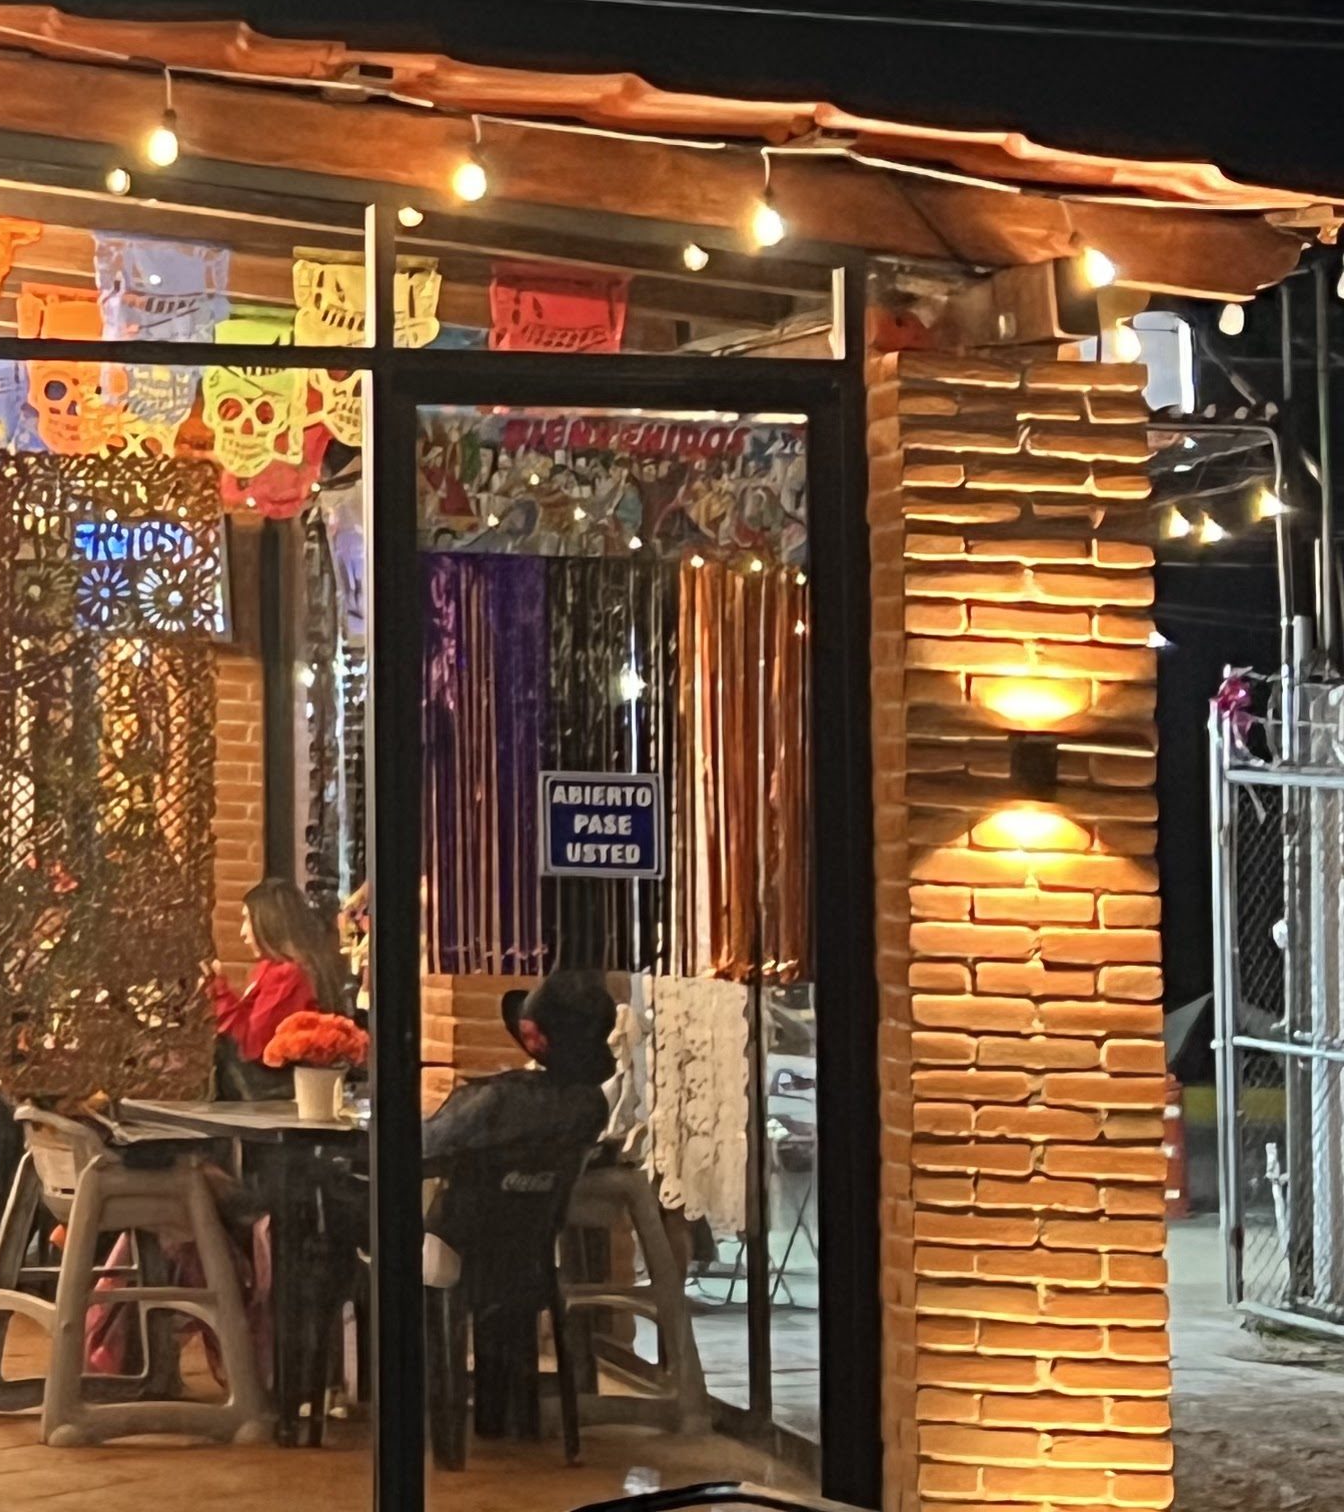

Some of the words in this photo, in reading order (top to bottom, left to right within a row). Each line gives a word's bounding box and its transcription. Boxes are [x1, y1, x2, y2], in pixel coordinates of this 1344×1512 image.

[552, 785, 652, 807] ABIERTO
[574, 814, 632, 835] PASE
[566, 842, 640, 864] USTED
